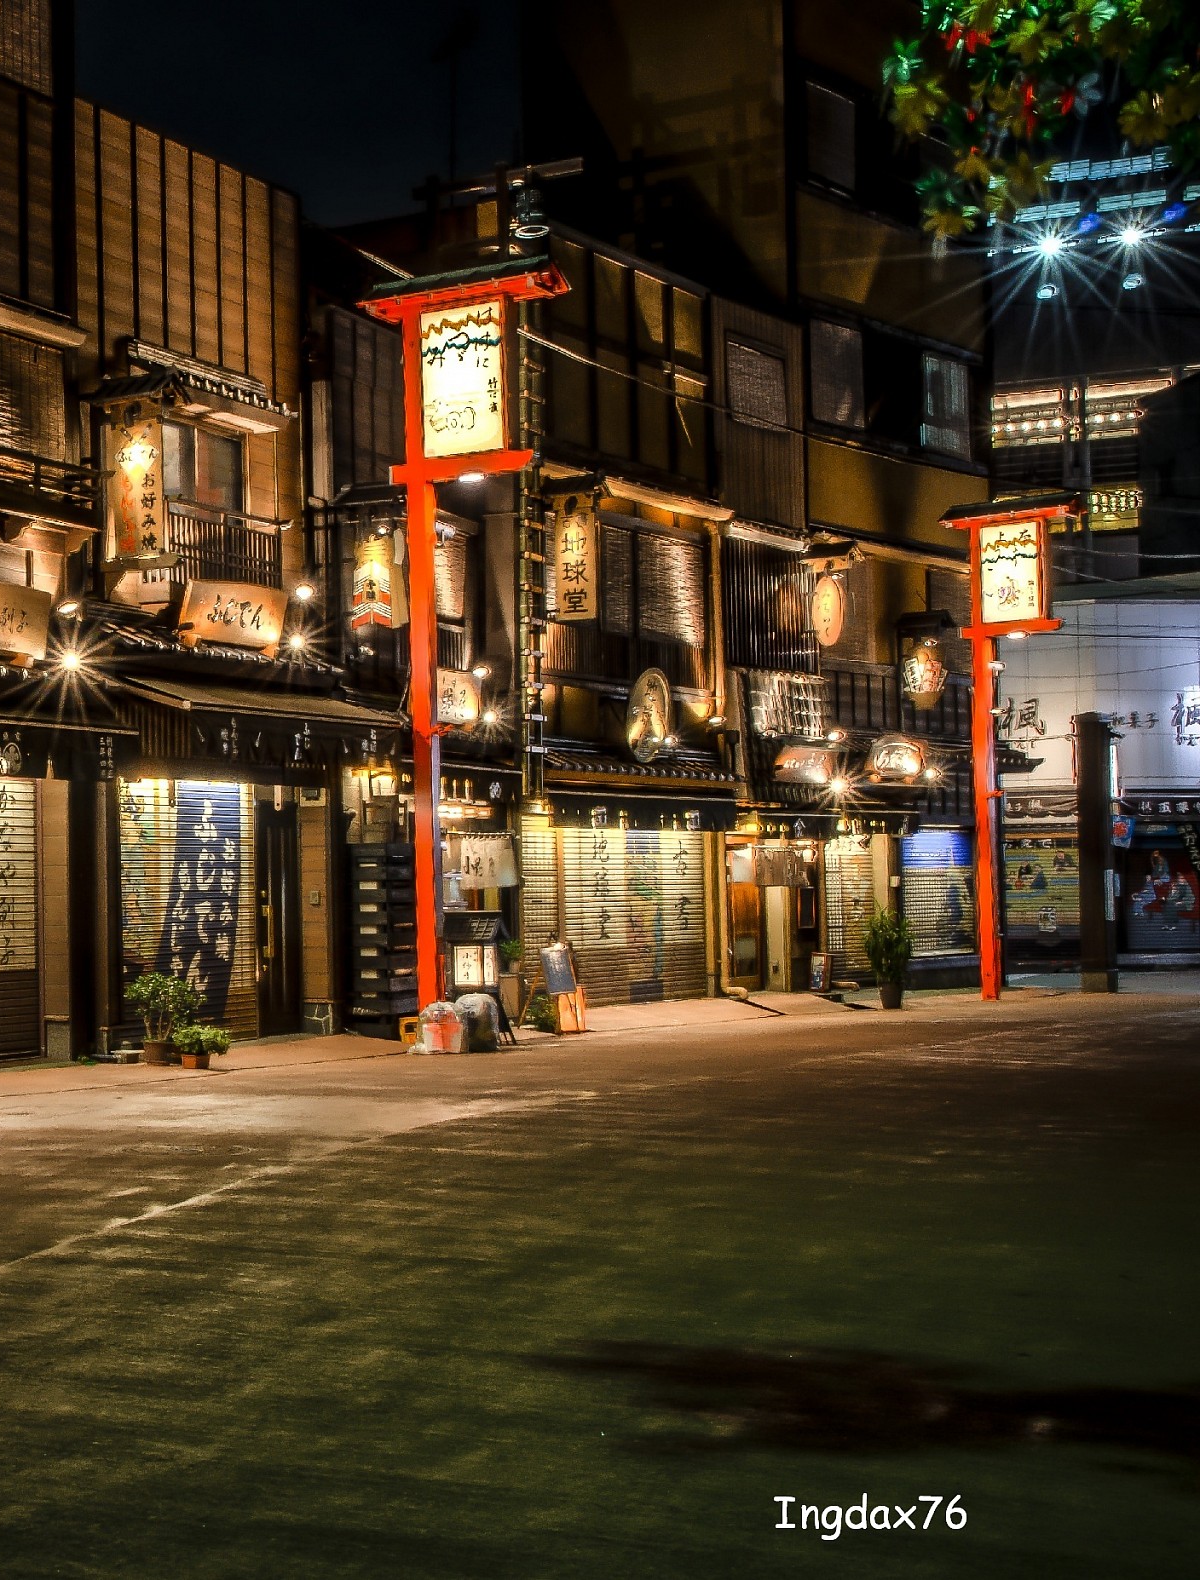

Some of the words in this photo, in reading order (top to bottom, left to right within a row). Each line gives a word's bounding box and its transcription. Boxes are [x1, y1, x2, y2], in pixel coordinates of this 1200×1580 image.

[141, 473, 157, 550] お好み焼
[561, 531, 589, 614] 地球堂
[999, 697, 1046, 739] 楓
